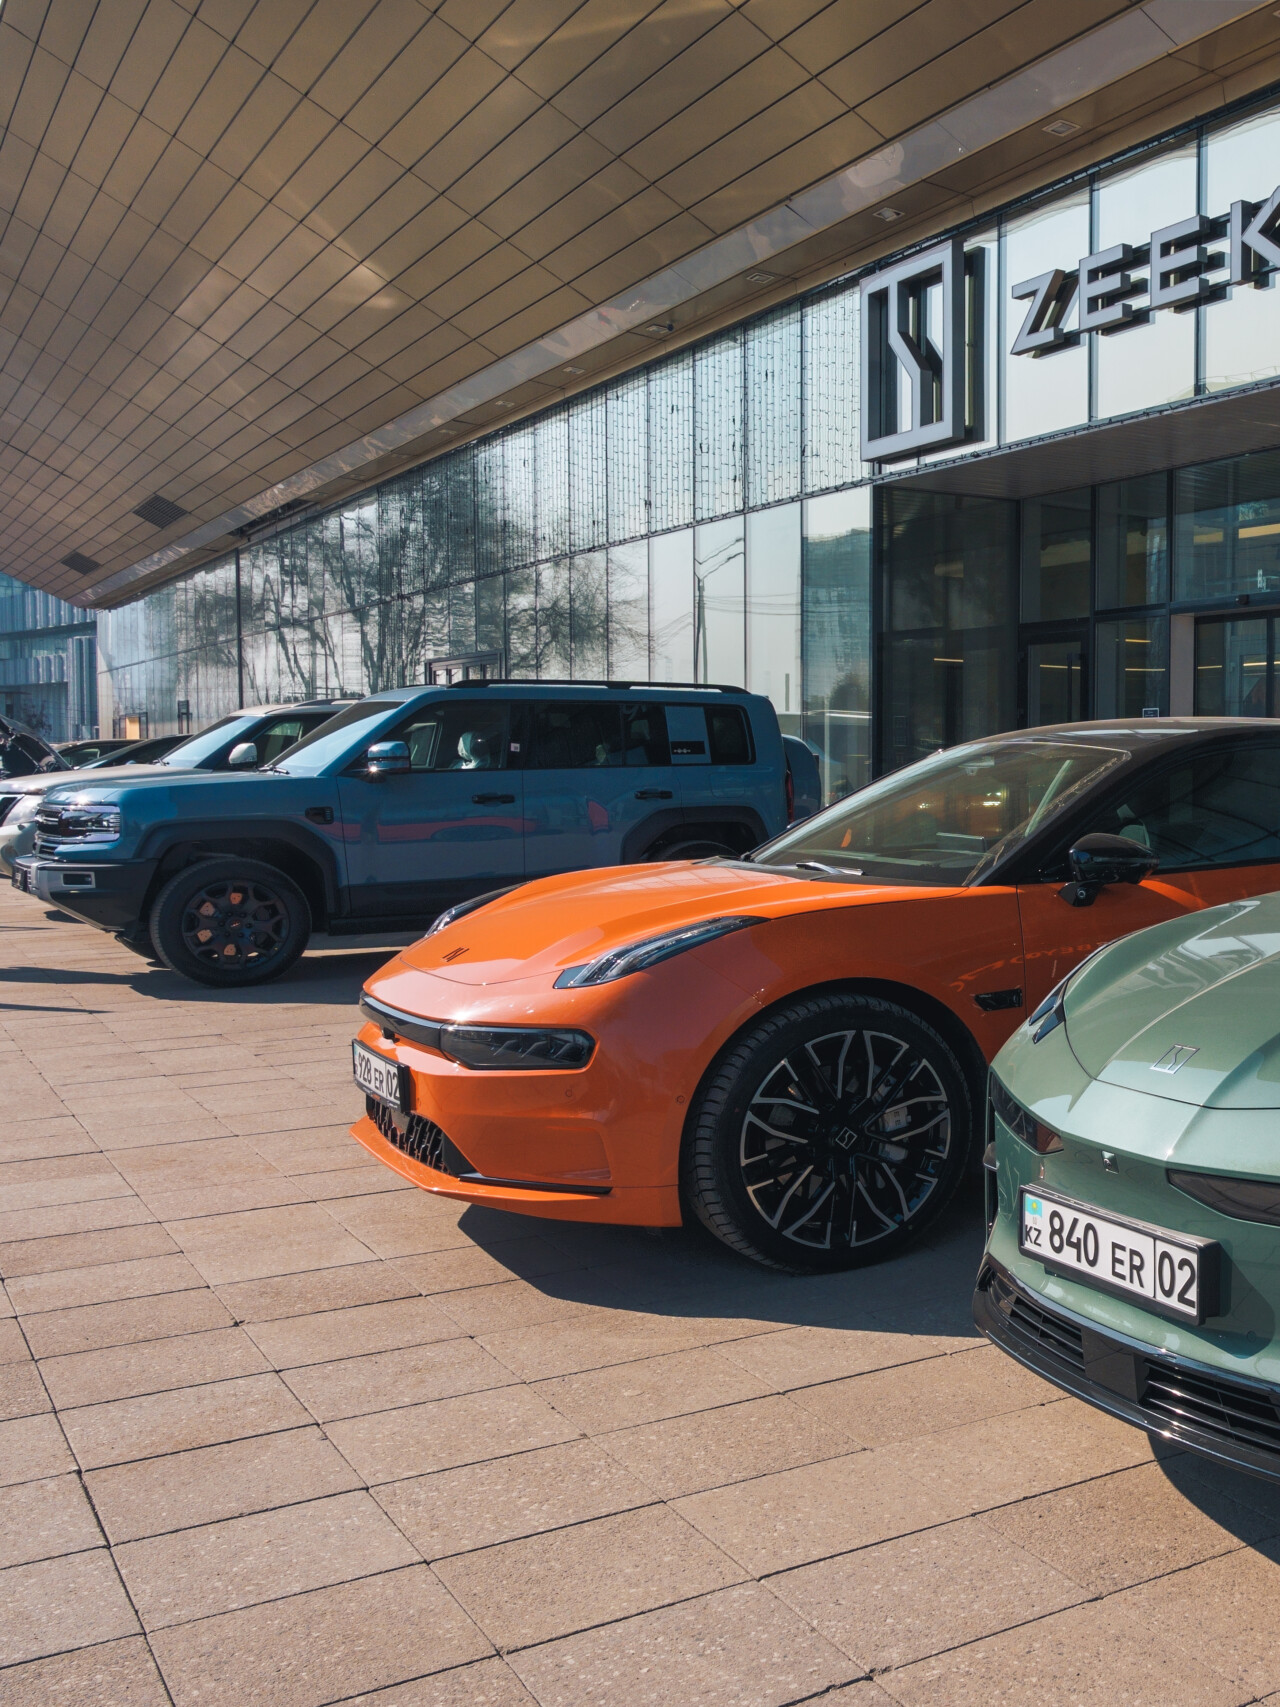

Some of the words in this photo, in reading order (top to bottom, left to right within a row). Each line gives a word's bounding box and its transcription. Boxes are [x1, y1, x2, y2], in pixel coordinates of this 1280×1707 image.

[374, 1067, 384, 1093] ER
[387, 1068, 400, 1101] 02
[1025, 1223, 1042, 1247] KZ
[1049, 1209, 1099, 1268] 840
[1111, 1241, 1145, 1288] ER
[1158, 1250, 1196, 1309] 02
